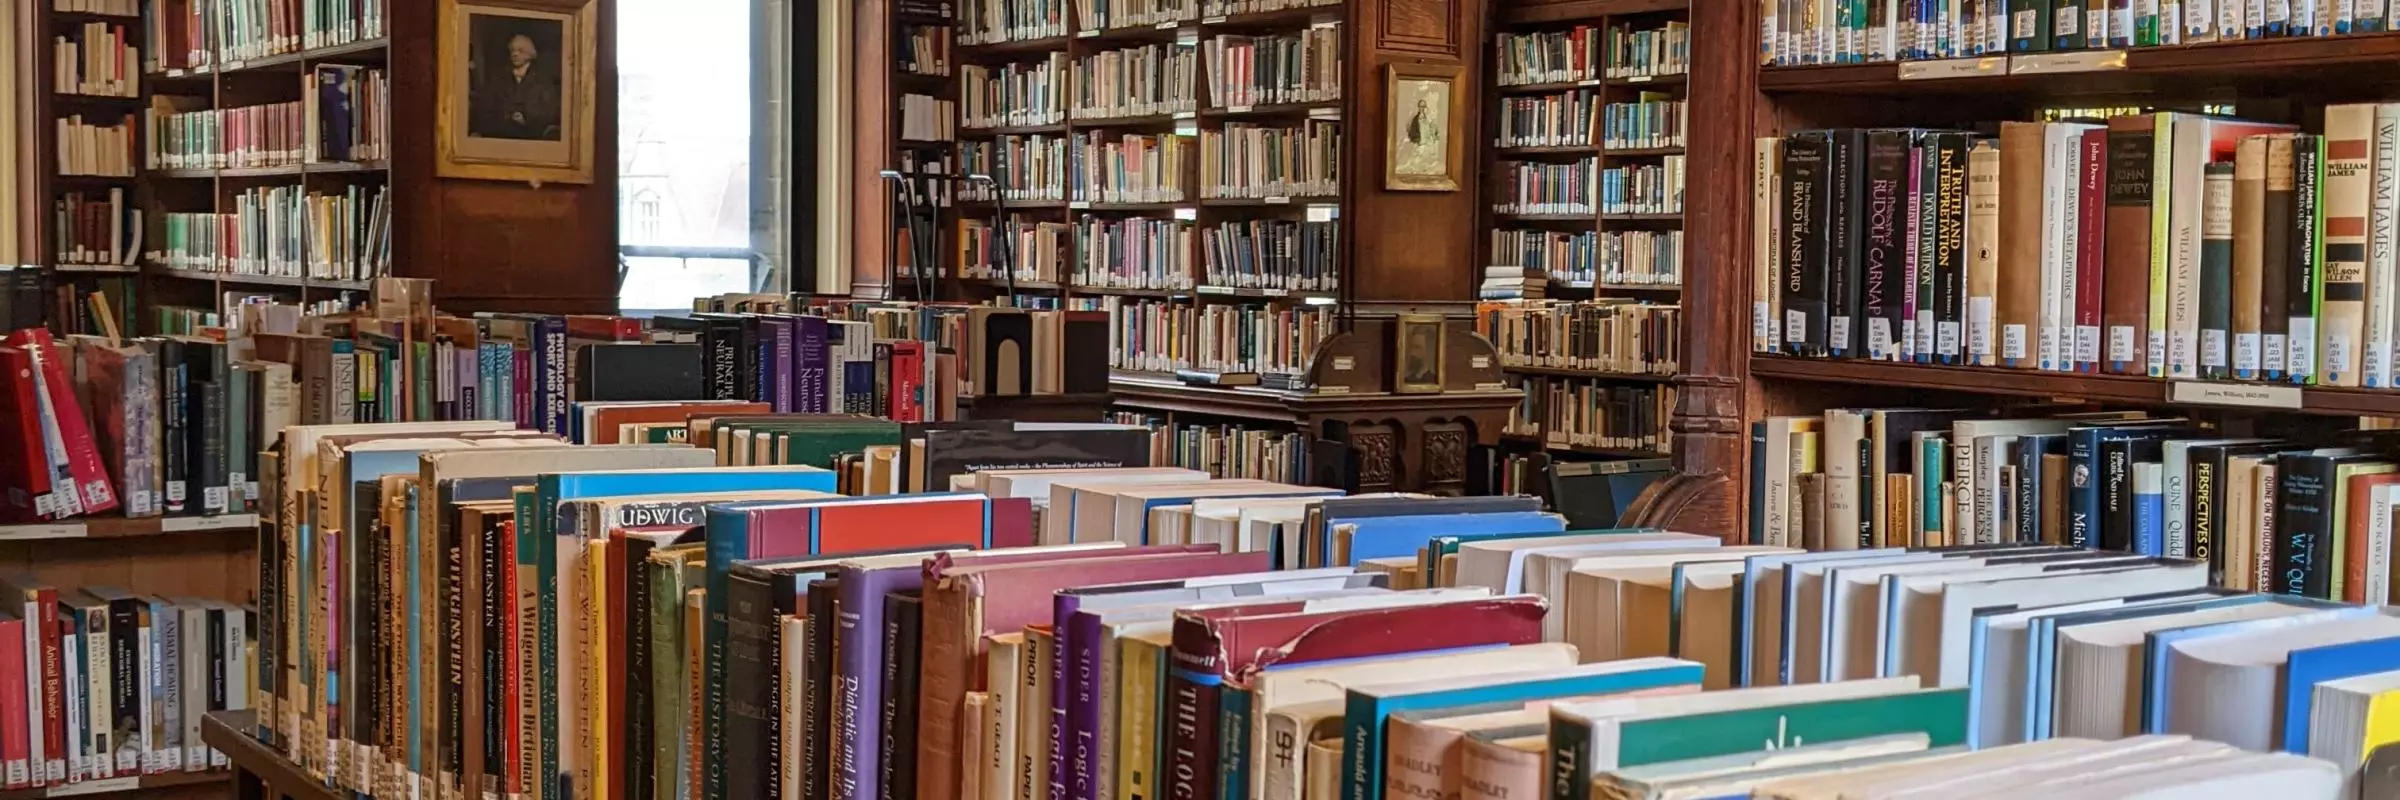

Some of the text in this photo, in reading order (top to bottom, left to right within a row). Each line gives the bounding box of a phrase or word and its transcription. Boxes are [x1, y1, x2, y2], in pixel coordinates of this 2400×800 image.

[2087, 163, 2098, 190] Dewey
[2090, 142, 2100, 161] John
[2306, 152, 2315, 184] WILLIAM
[2327, 162, 2368, 171] WILLIAM
[2327, 169, 2356, 177] JAMES
[1921, 192, 1934, 236] DONALD
[1939, 149, 1954, 267] INTERPRETATION
[1950, 166, 1964, 250] TRUTH AND
[2066, 188, 2076, 233] DEWEY'S
[2305, 184, 2314, 210] JAMES
[2372, 123, 2395, 259] WILLIAM JAMES
[1790, 181, 1804, 292] BRAND BLANSHARD
[1868, 180, 1888, 315] RUDOLF CARNAP
[1920, 237, 1932, 286] DAVIDSON
[2303, 216, 2313, 265] PRAGMATISM
[2064, 234, 2074, 300] METAPHYSICS
[2176, 227, 2191, 322] WILLIAM JAMES
[2302, 276, 2310, 293] focus
[546, 333, 556, 366] SPORT
[556, 333, 565, 414] PHYSIOLOGY OF
[715, 340, 725, 385] NEURAL
[340, 356, 352, 417] INSECTS
[546, 368, 556, 391] AND
[1956, 444, 1971, 514] PEIRCE
[2116, 451, 2124, 474] Edited
[2264, 475, 2273, 500] QUINE
[1770, 480, 1782, 511] James
[2022, 477, 2032, 533] REASONING
[2169, 476, 2183, 557] QUINE Quidd
[2197, 463, 2210, 543] PERSPECTIVES
[2263, 502, 2272, 514] ON
[2291, 533, 2305, 548] W.
[484, 530, 494, 627] WITTGENSTEIN
[450, 547, 461, 685] WITTGENSTEIN
[772, 607, 780, 667] EPISTEMIC
[165, 620, 178, 708] ANIMAL HOMING
[580, 596, 589, 750] WITTGENSTEIN
[1027, 639, 1036, 687] PRIOR
[1053, 625, 1063, 680] SIDER
[46, 645, 60, 719] Animal Behavior
[520, 588, 536, 798] A Wittgenstein Dictionary
[771, 674, 779, 709] LOGIC
[711, 682, 722, 758] HISTORY
[771, 716, 778, 730] IN
[843, 675, 859, 797] Dialectic and Its
[886, 698, 896, 731] The
[1074, 647, 1091, 790] SIDER Logic
[884, 735, 894, 780] Circle
[993, 722, 1001, 768] GEACH
[1049, 707, 1066, 775] Logic
[1175, 688, 1197, 800] THE LOG
[1354, 724, 1368, 783] Arnauld
[770, 761, 778, 797] LATER
[1556, 746, 1577, 796] The
